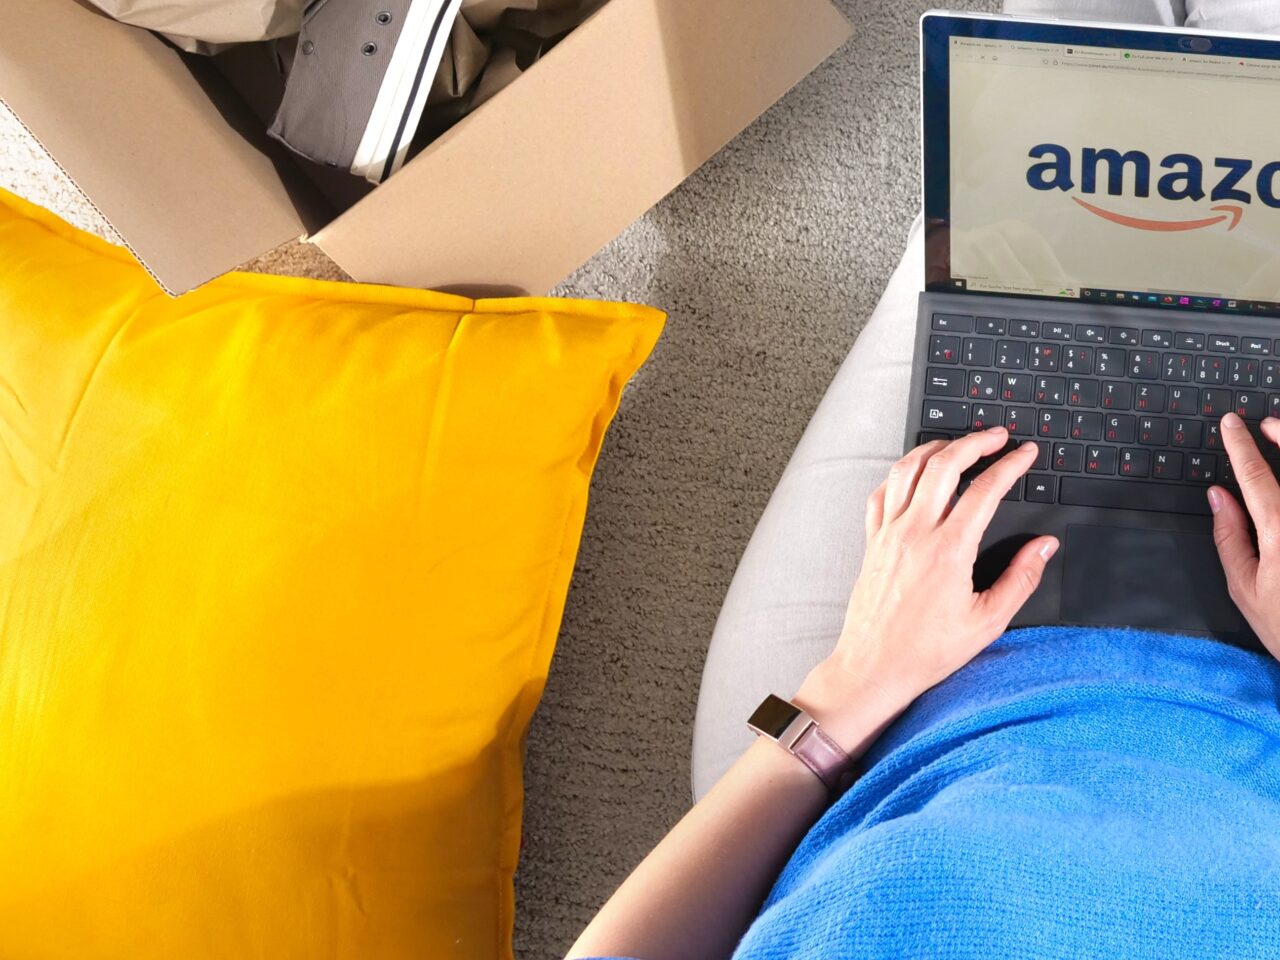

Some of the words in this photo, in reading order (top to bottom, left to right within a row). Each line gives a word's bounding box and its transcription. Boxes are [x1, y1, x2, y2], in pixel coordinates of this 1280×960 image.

[974, 375, 982, 385] Q
[1007, 378, 1017, 386] W
[1240, 395, 1249, 404] O
